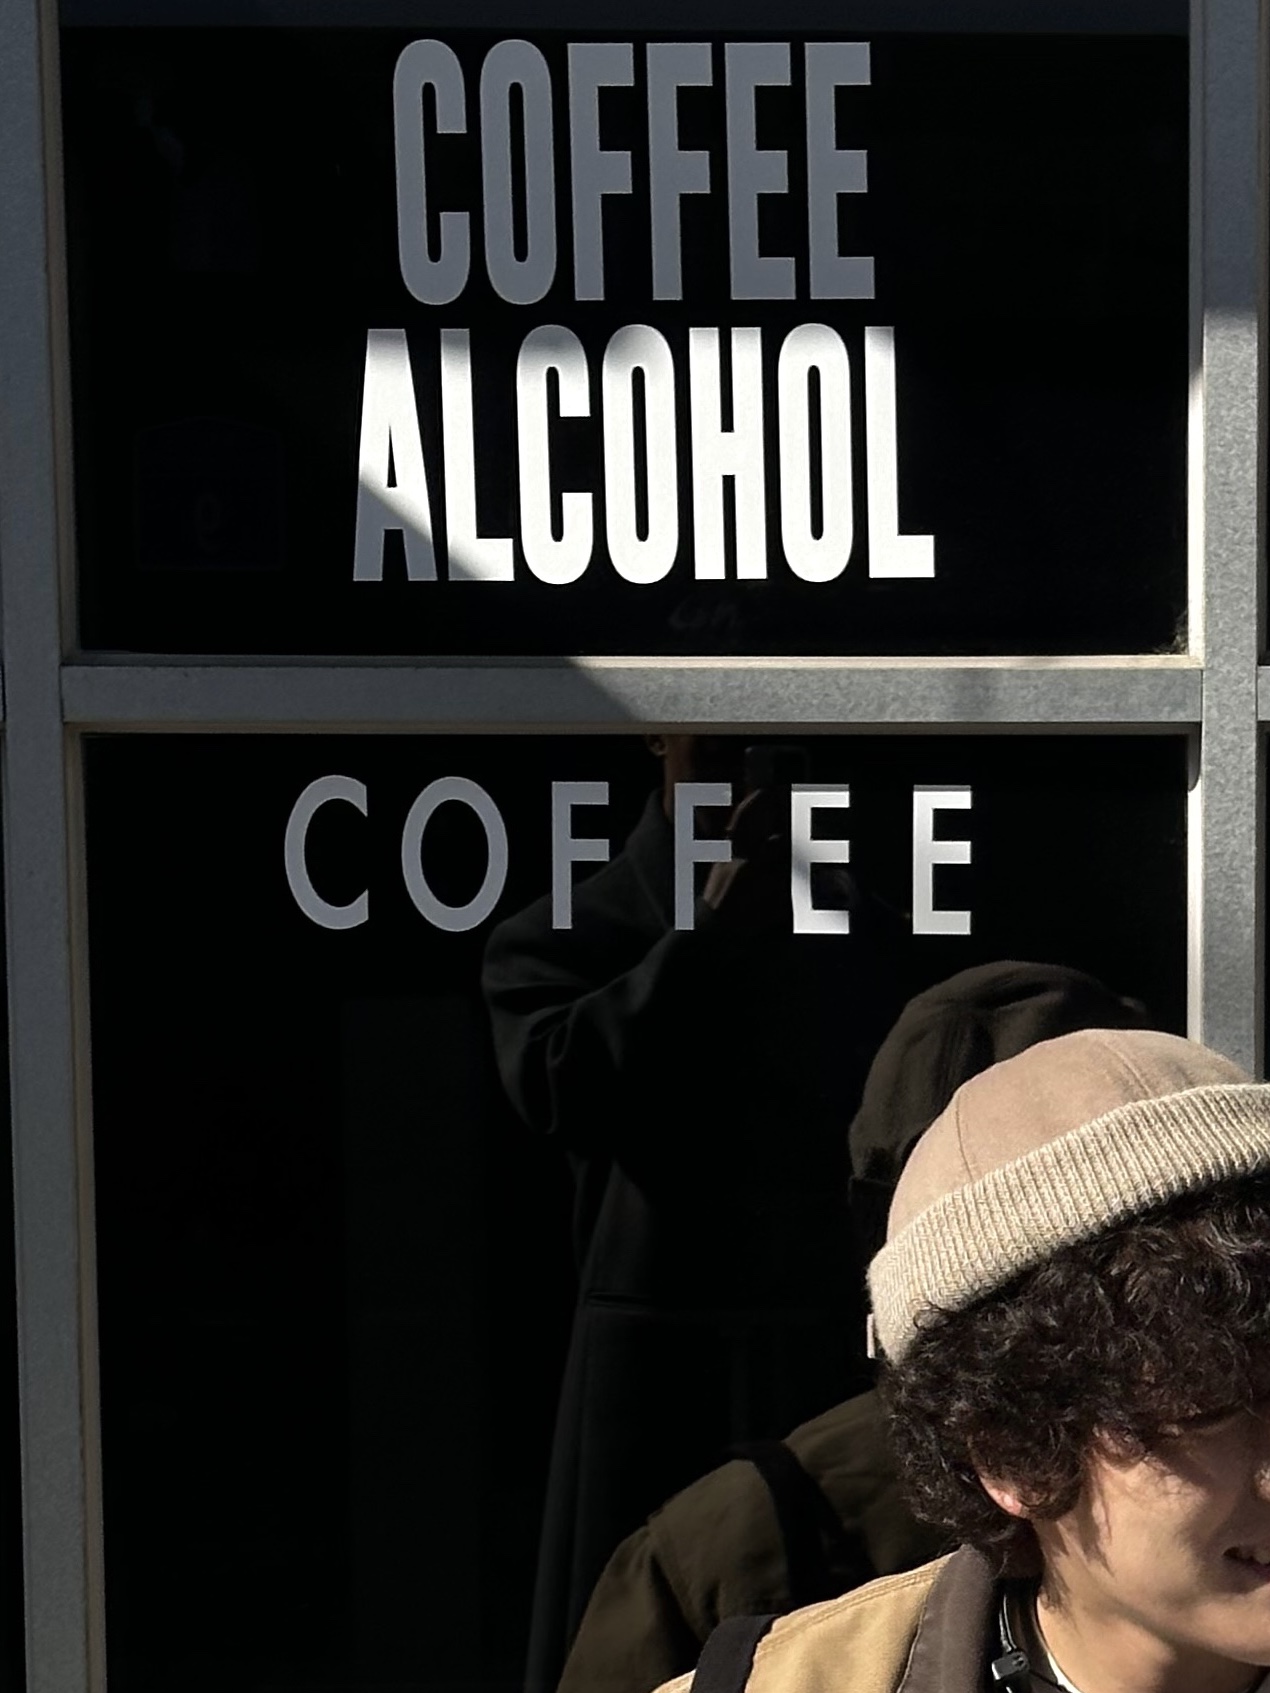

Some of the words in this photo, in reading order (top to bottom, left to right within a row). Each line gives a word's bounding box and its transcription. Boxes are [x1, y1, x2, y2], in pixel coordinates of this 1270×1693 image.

[393, 38, 876, 306] COFFEE
[353, 322, 936, 585] ALCOHOL
[284, 774, 973, 936] COFFEE
